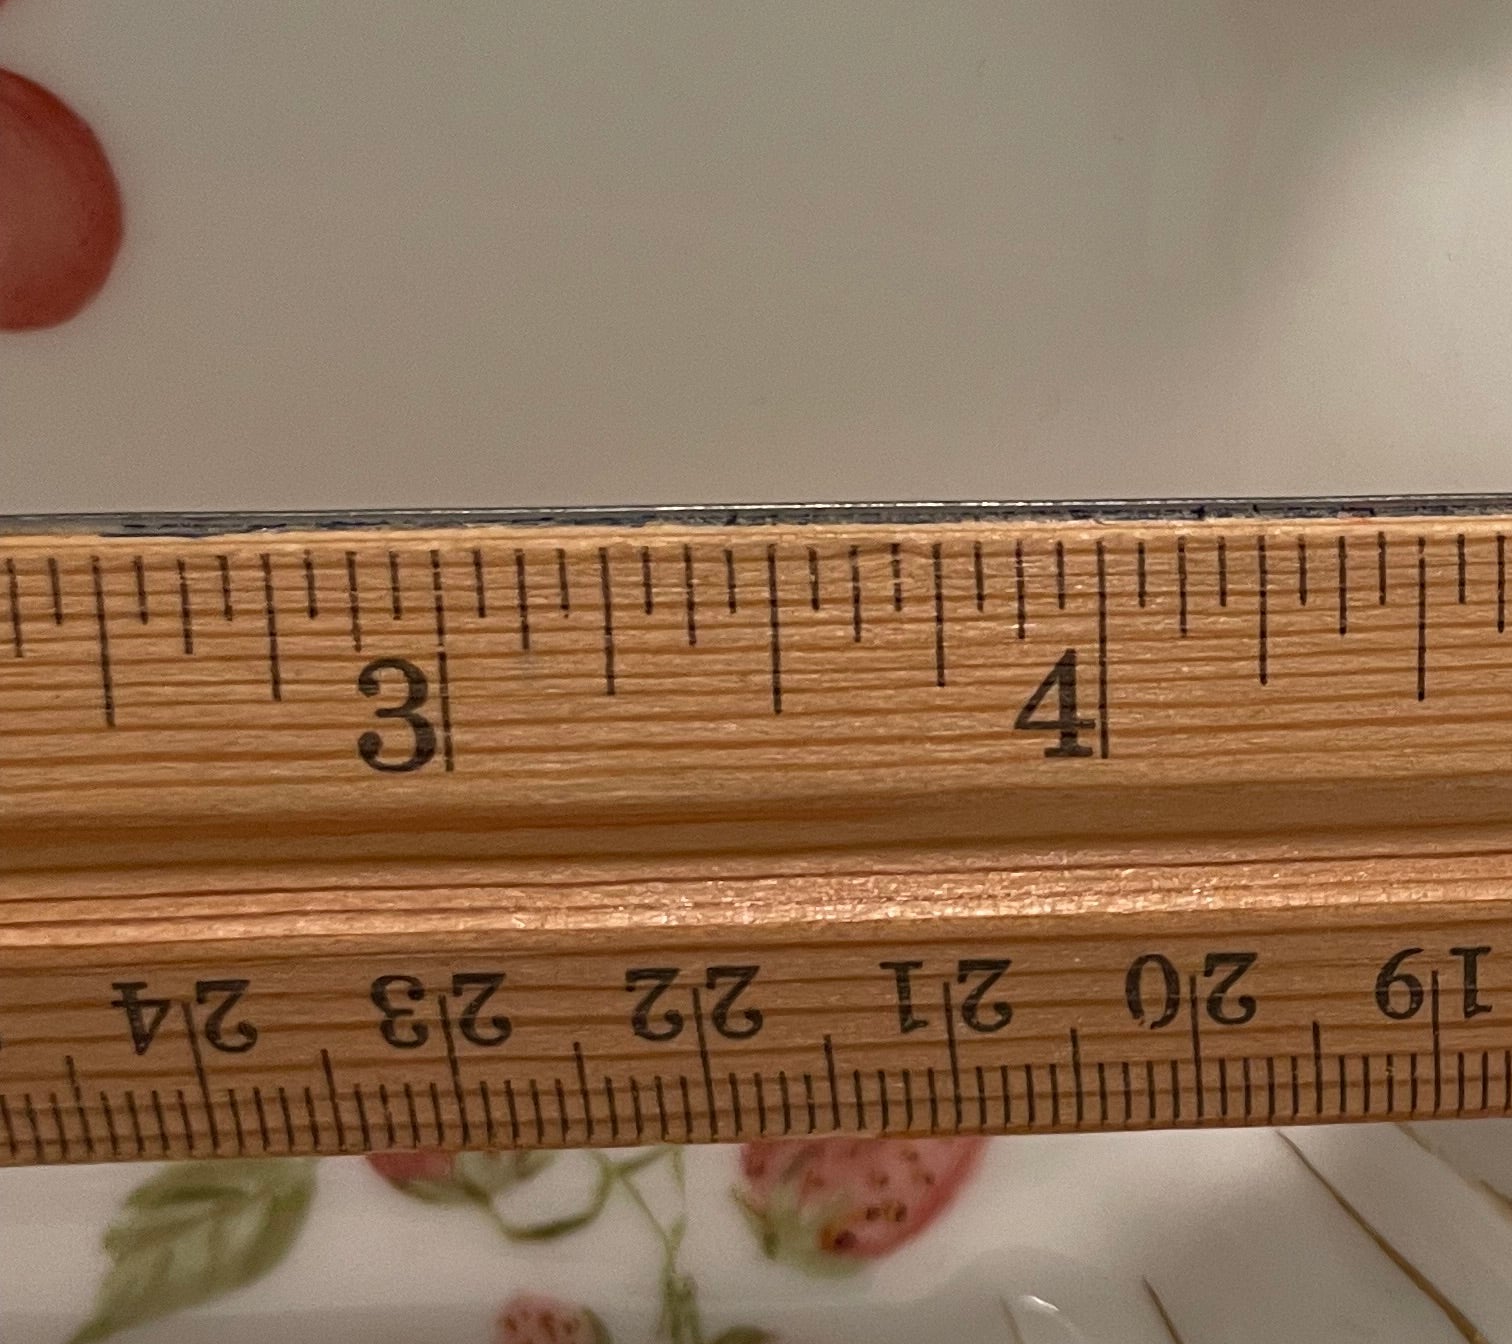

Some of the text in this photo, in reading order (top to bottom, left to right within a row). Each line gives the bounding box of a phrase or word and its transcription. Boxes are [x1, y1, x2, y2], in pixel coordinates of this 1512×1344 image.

[356, 658, 438, 774] 3
[1014, 648, 1096, 759] 4
[111, 978, 258, 1055] 24
[369, 972, 513, 1050] 23
[624, 965, 764, 1042] 22
[879, 958, 1013, 1034] 21
[1125, 951, 1258, 1029] 20
[1374, 945, 1493, 1021] 19
